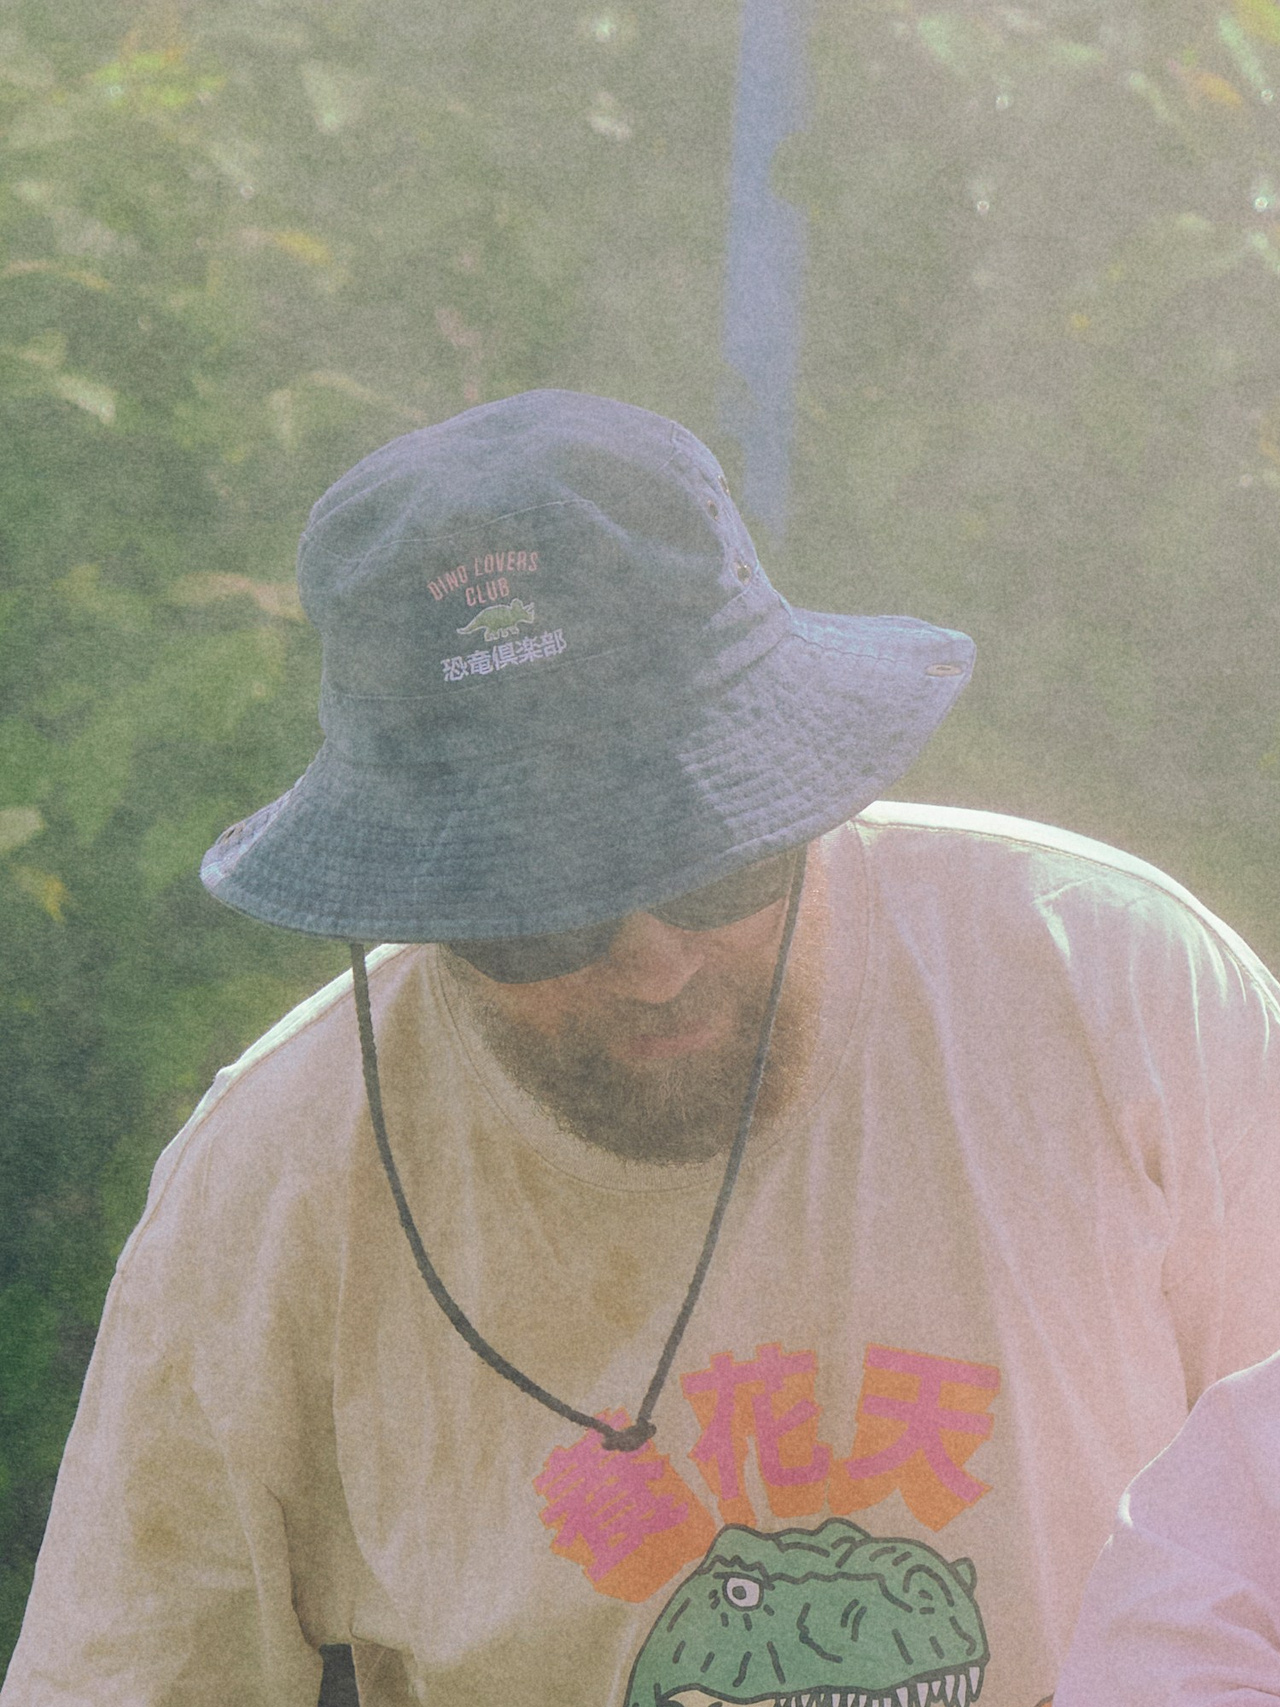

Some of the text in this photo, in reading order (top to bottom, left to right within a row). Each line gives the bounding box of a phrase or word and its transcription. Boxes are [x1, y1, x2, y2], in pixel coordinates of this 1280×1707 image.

[427, 551, 539, 601] DINO LOVERS
[465, 577, 510, 606] CLUB
